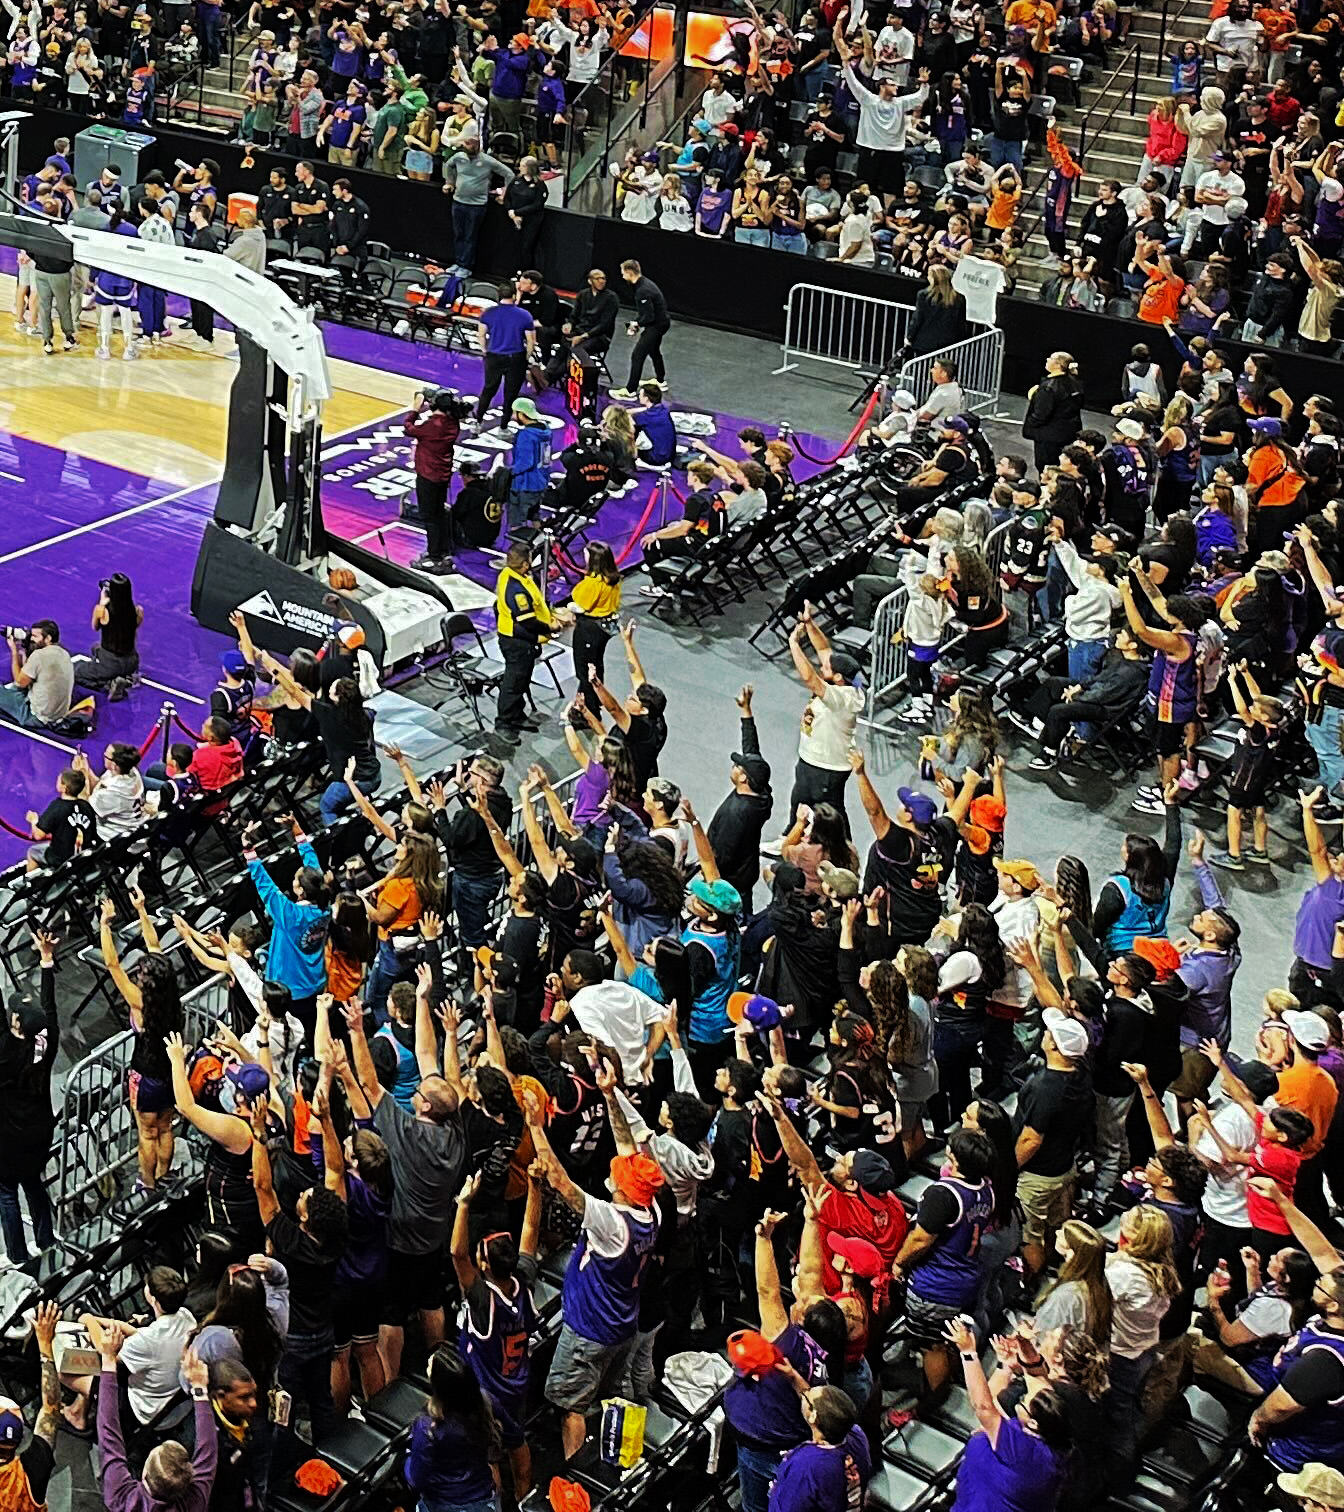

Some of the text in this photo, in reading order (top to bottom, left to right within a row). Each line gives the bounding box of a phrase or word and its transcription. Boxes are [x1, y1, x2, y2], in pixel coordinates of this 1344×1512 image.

[322, 445, 411, 483] CASINOS
[1016, 538, 1033, 555] 23
[281, 600, 335, 627] MOUNTAIN
[282, 611, 329, 635] AMERICA
